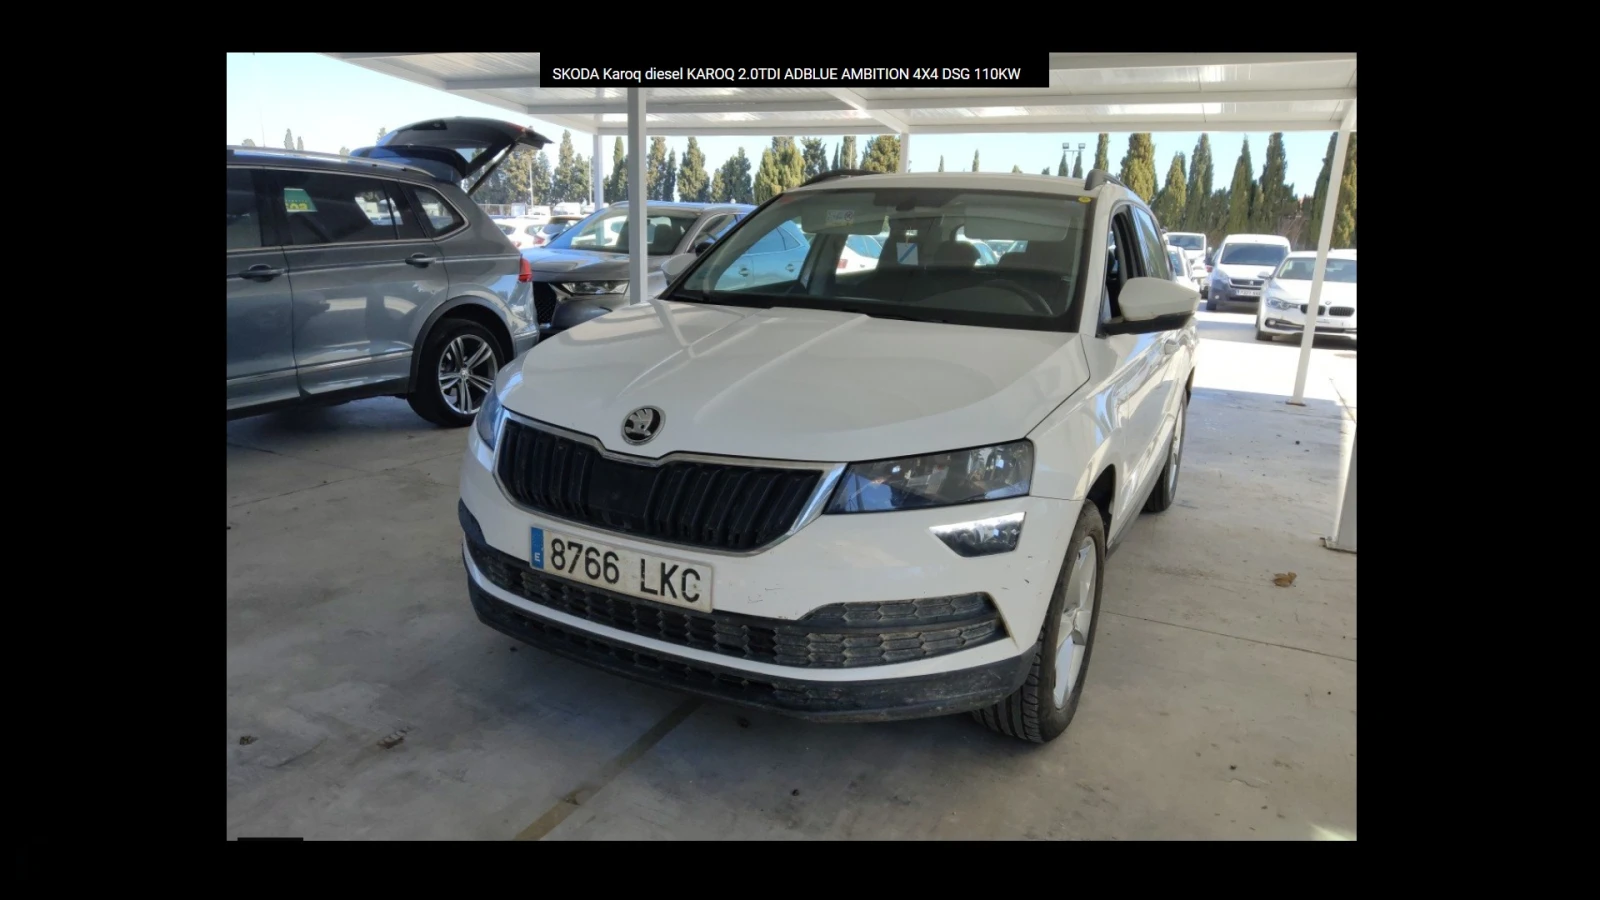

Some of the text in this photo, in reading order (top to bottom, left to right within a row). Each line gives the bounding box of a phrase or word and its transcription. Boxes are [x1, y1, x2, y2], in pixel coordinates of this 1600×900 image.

[534, 537, 701, 604] E 8766 LKC
